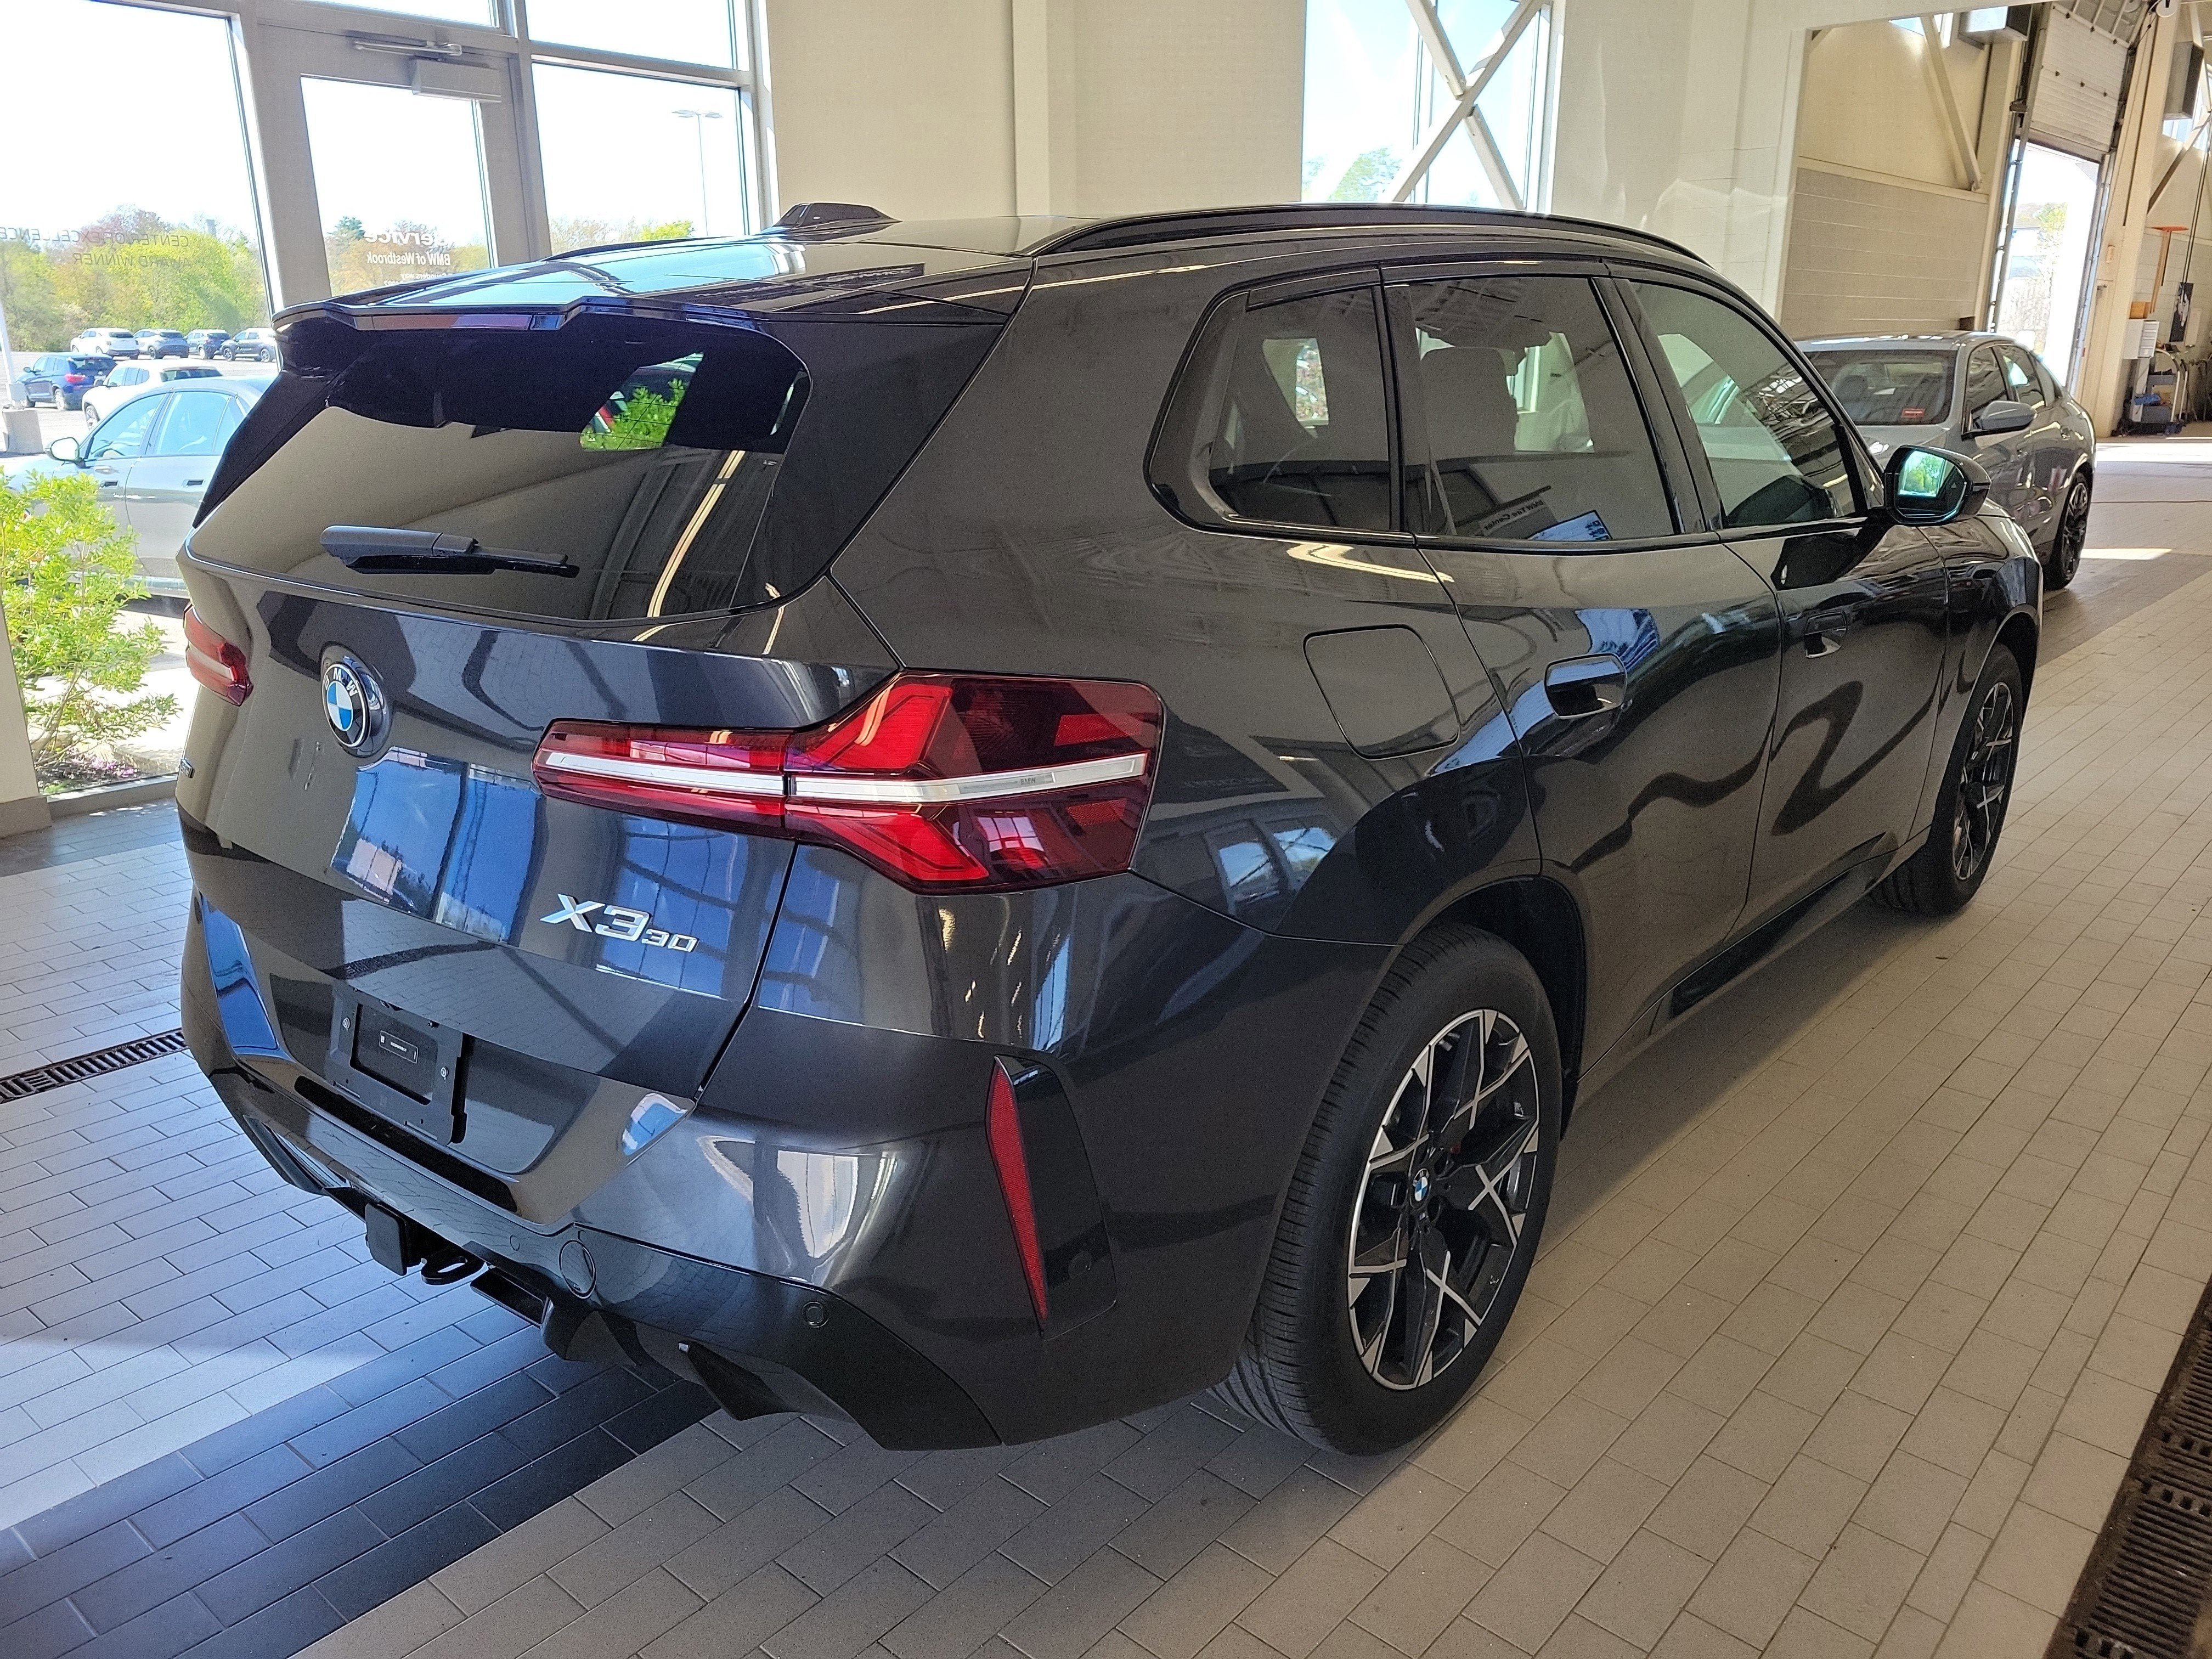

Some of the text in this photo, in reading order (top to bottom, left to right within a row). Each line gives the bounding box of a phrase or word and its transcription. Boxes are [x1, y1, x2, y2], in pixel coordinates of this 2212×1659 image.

[324, 667, 358, 697] BMW
[1020, 777, 1036, 785] BMW
[540, 894, 650, 941] X3
